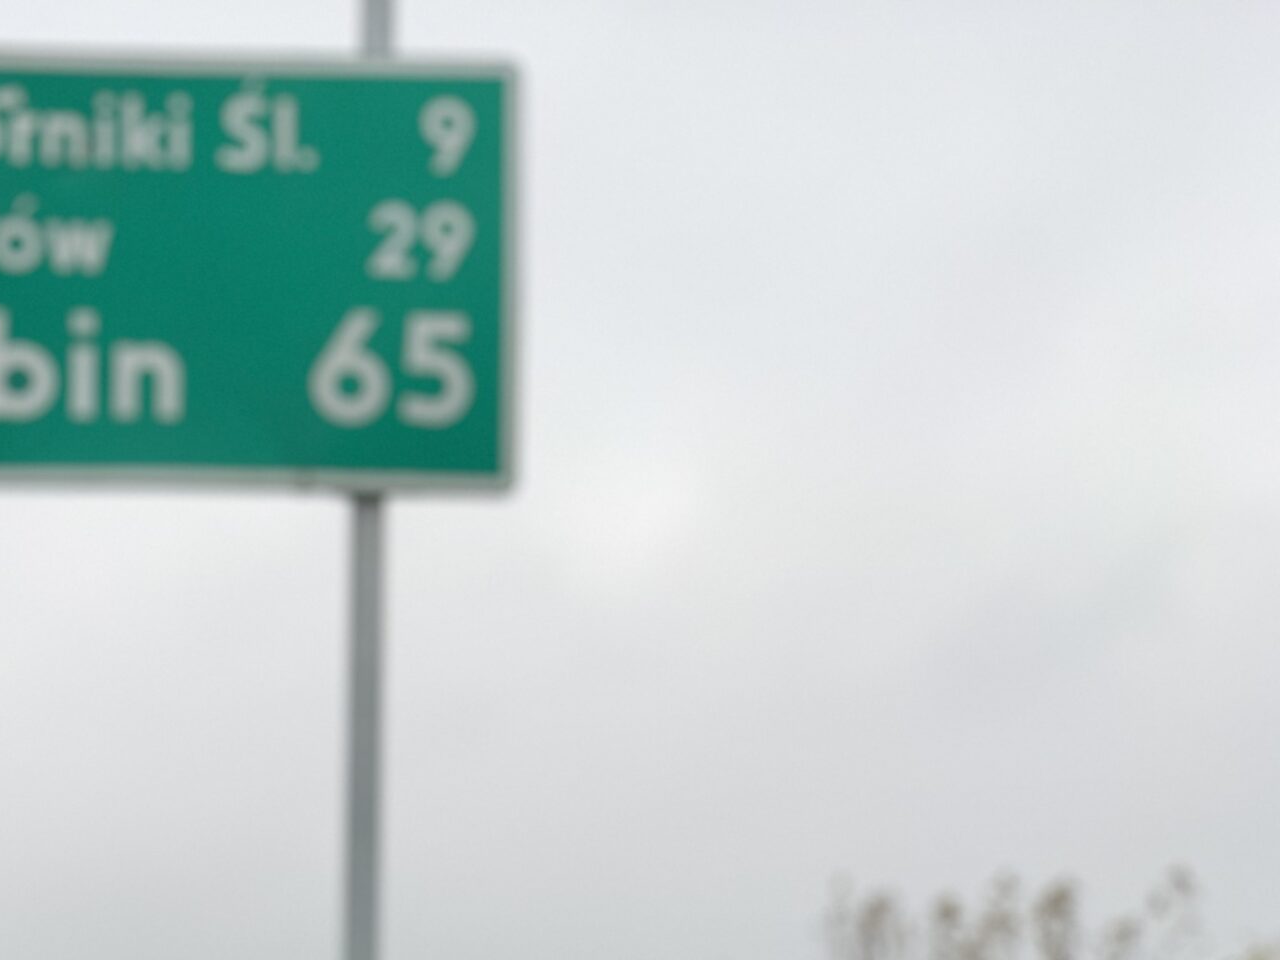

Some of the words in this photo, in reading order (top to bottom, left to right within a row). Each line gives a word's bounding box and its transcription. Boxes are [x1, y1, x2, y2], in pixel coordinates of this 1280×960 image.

[419, 95, 476, 175] 9
[366, 200, 476, 281] 29
[308, 307, 476, 428] 65
